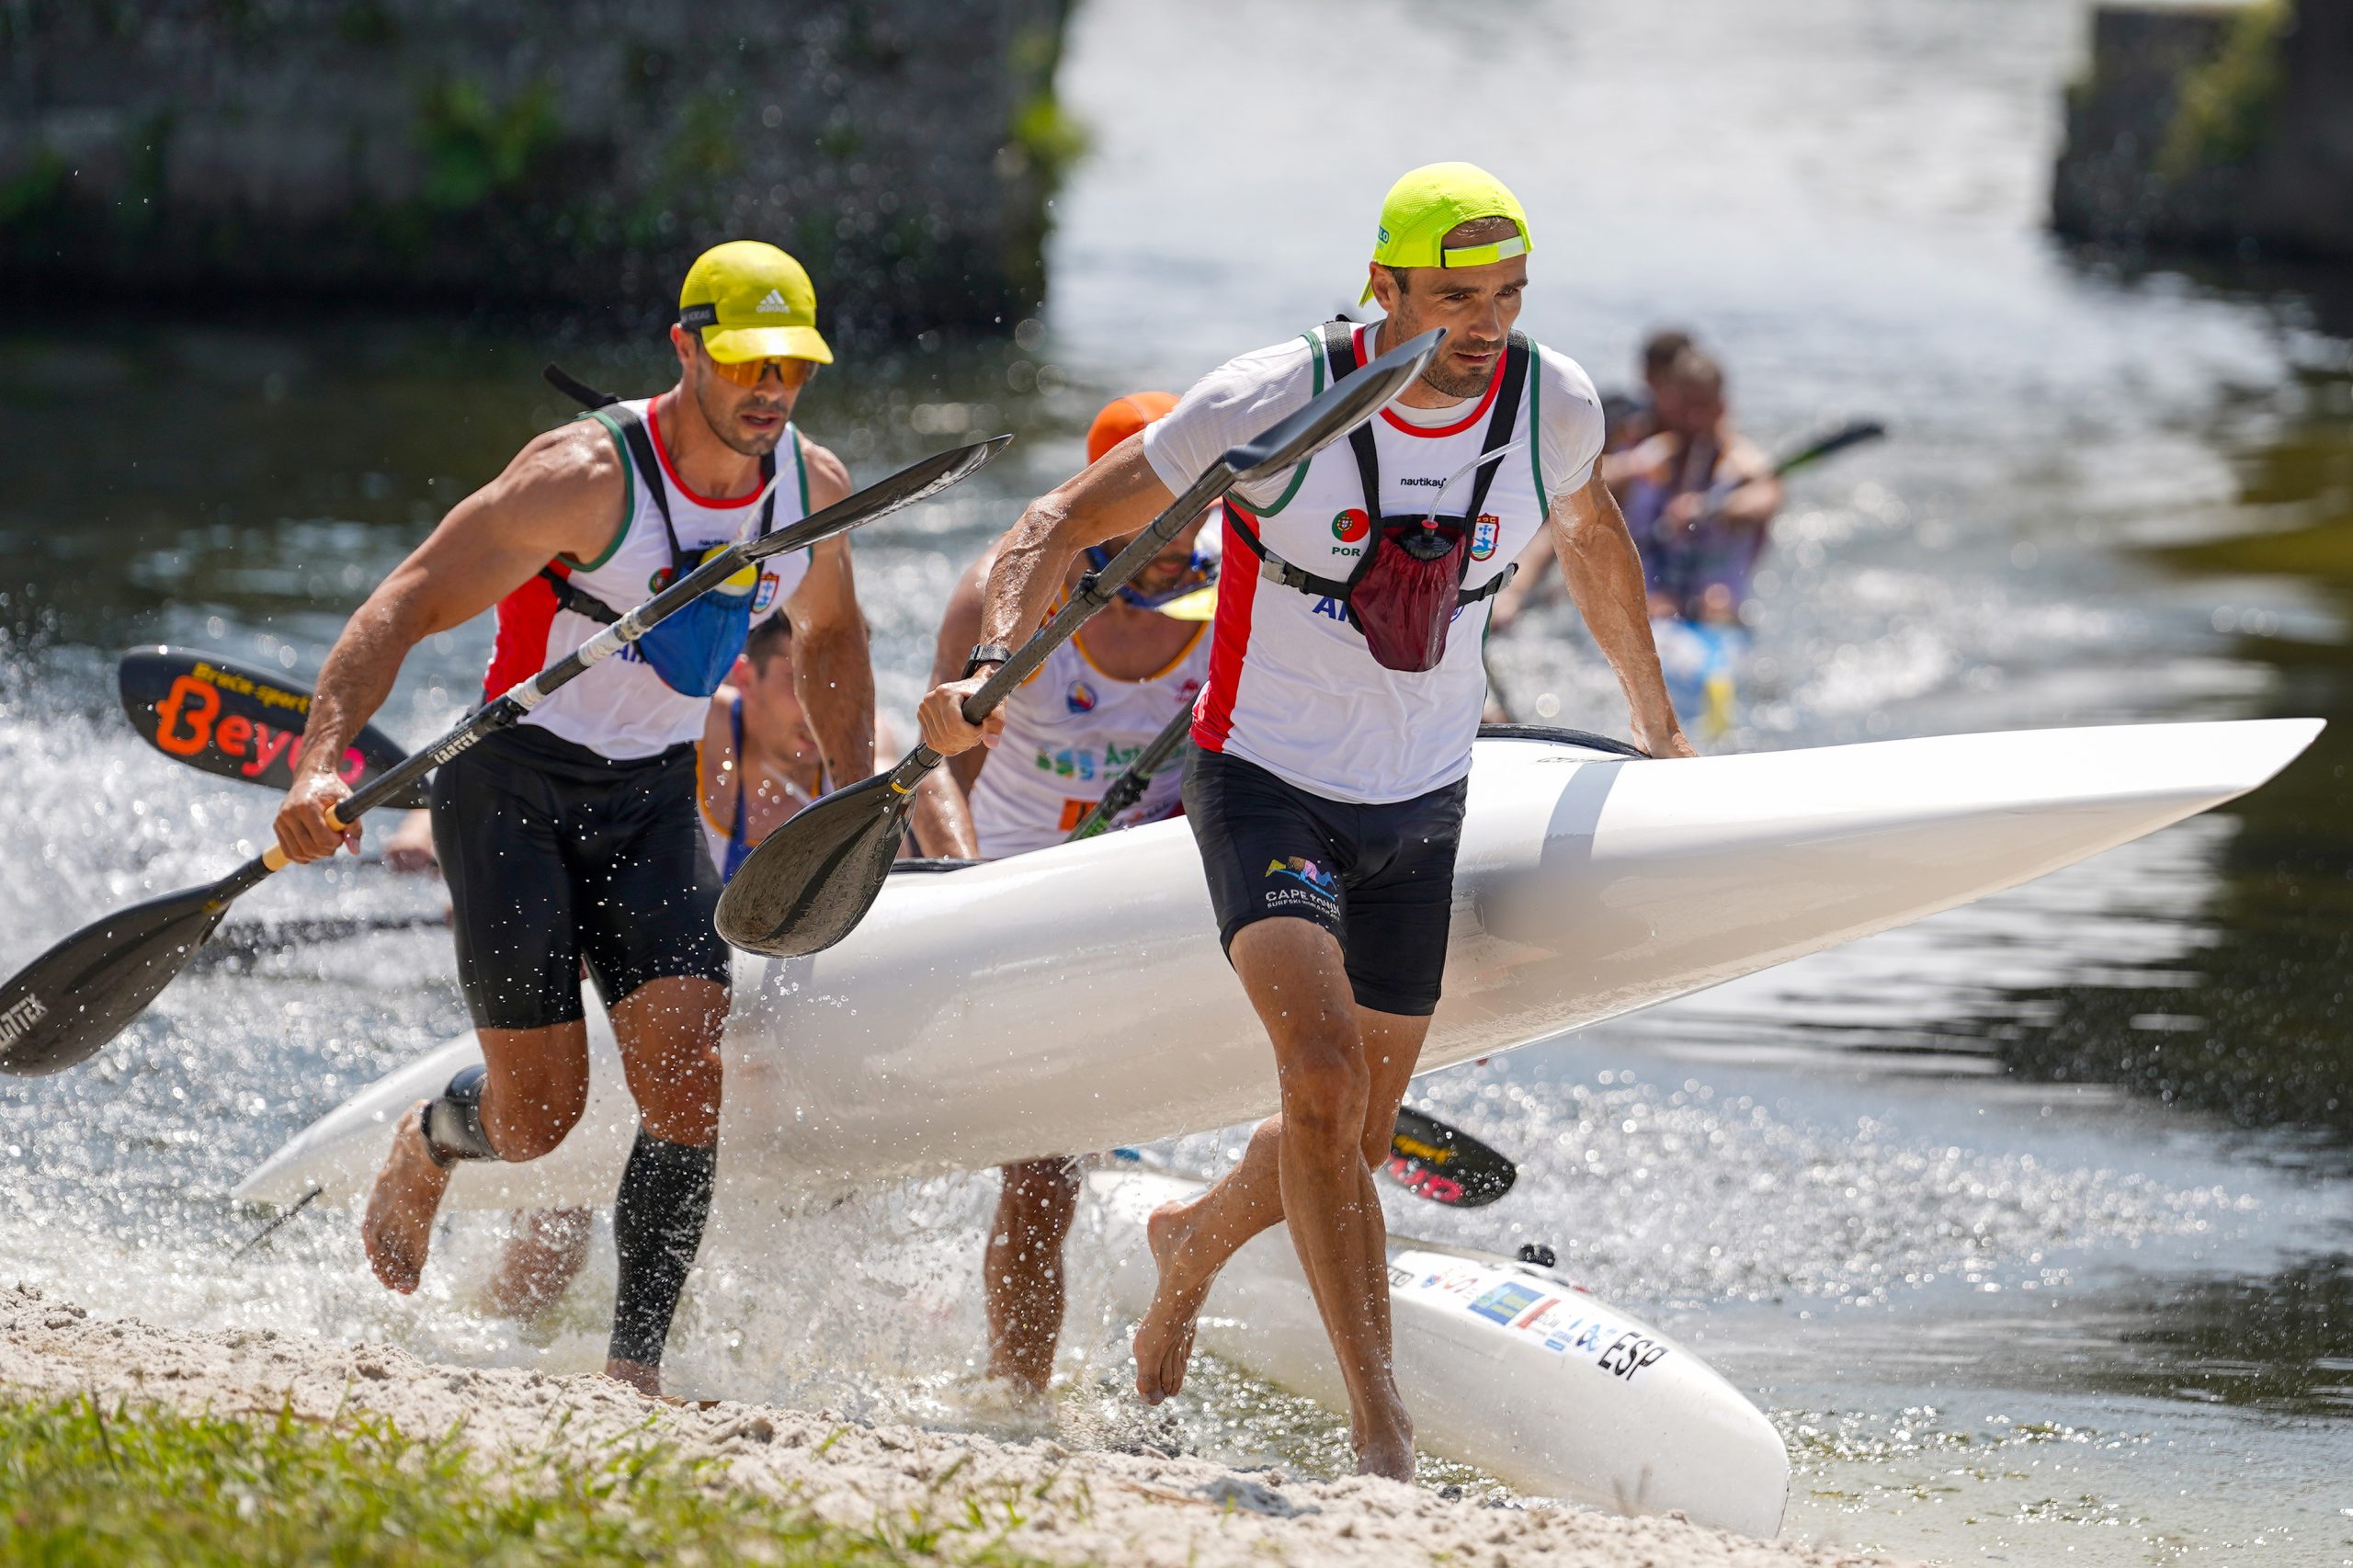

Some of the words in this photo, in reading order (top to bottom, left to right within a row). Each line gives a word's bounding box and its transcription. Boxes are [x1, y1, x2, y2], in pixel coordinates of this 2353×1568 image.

[756, 304, 790, 313] adidas
[1400, 477, 1445, 489] nautikay
[1332, 546, 1361, 557] POR
[1265, 889, 1309, 903] CAPE
[1597, 1331, 1669, 1381] ESP
